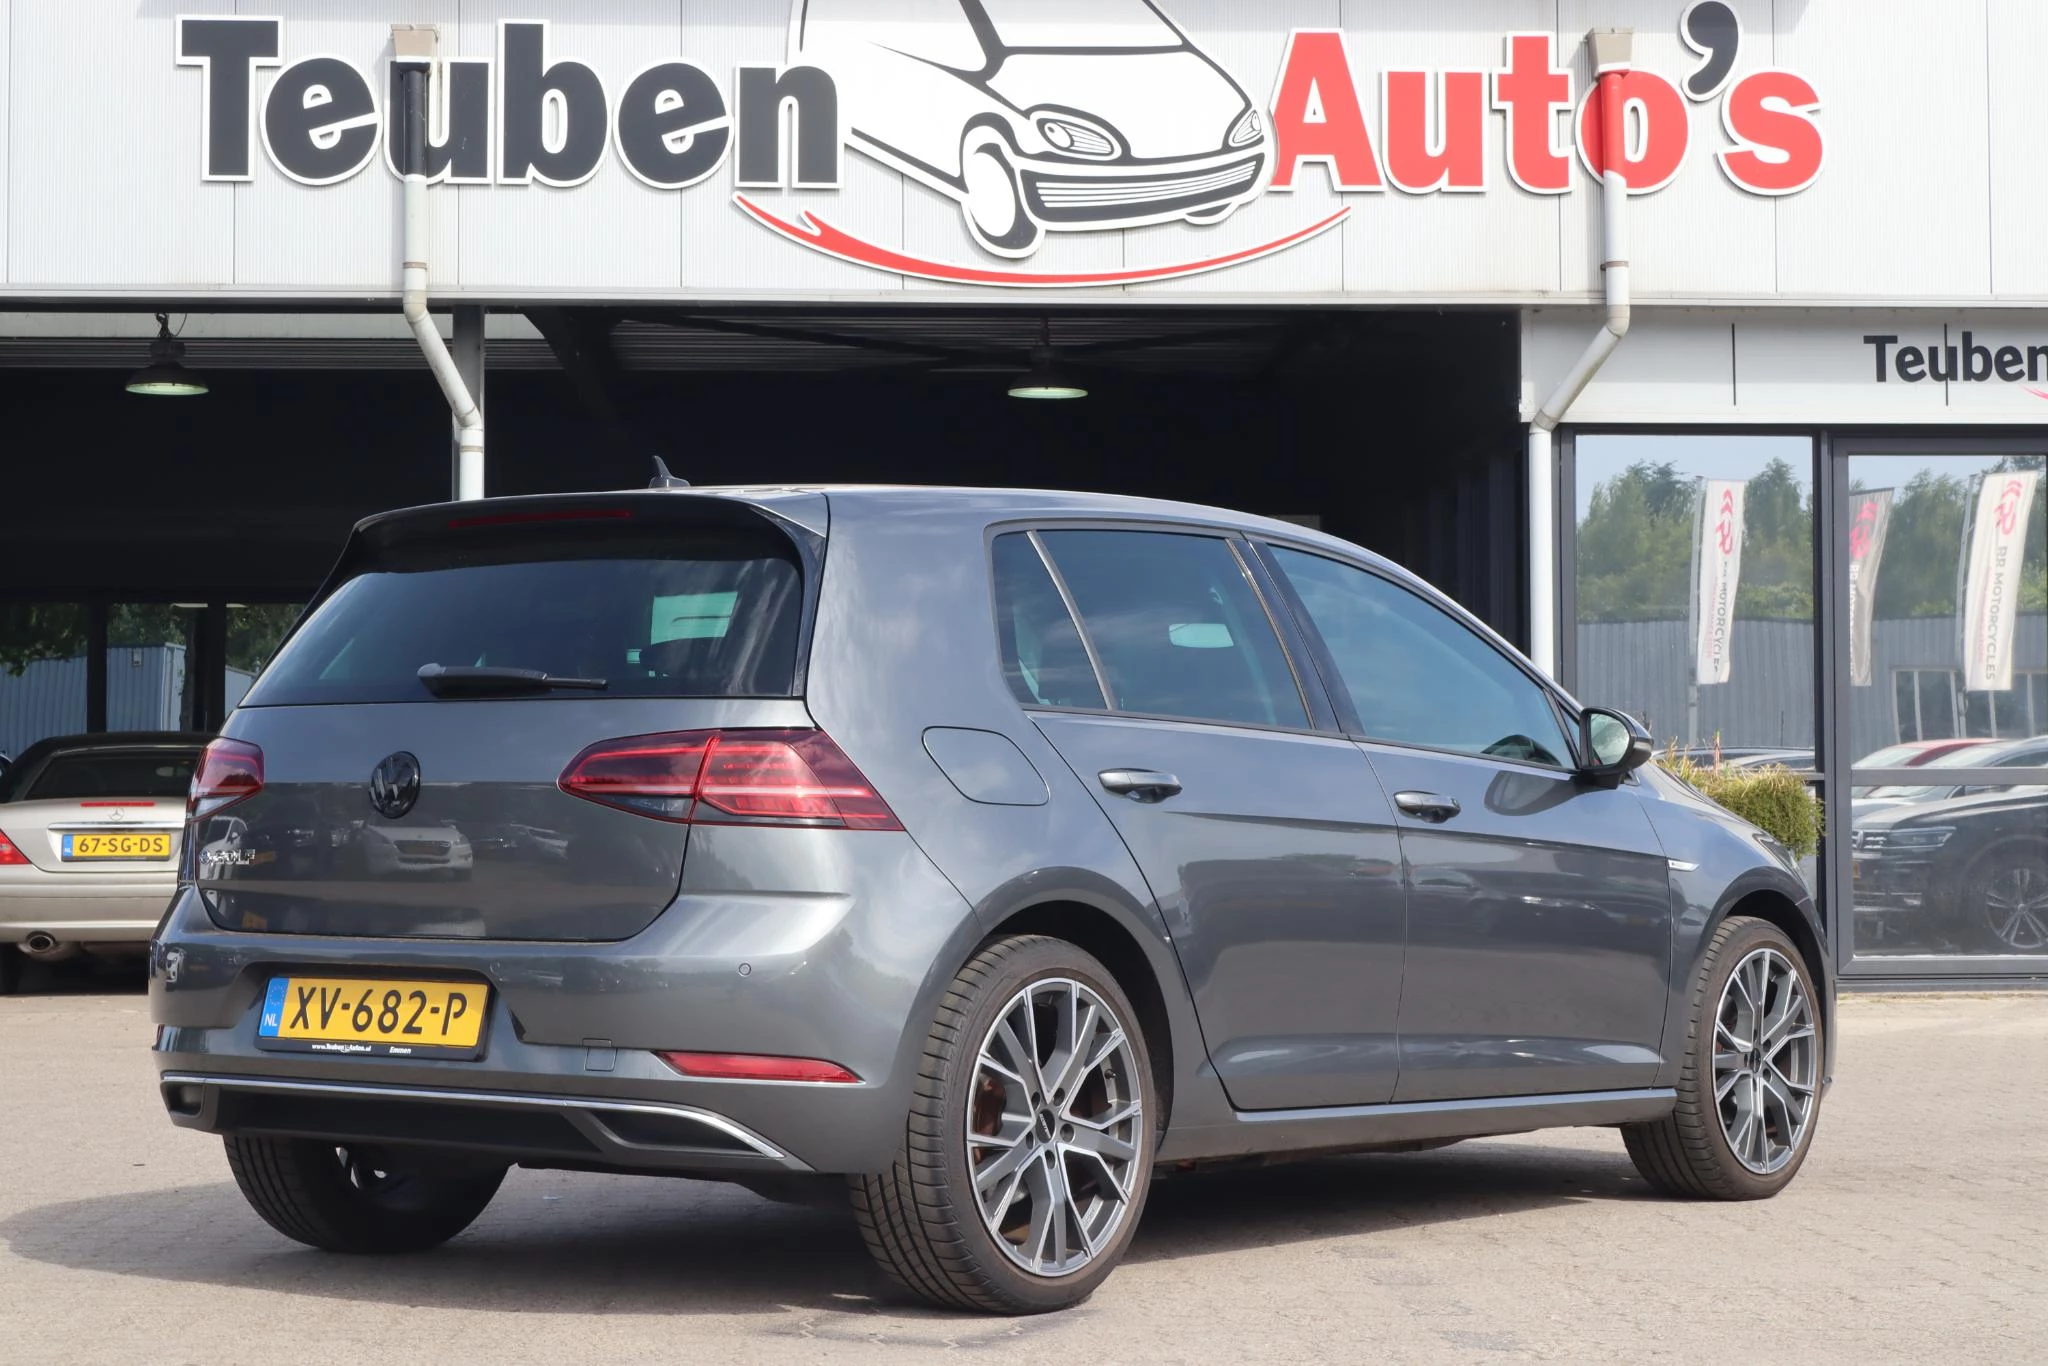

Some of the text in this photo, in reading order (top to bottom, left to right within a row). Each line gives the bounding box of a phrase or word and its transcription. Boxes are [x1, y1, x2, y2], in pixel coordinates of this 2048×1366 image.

[178, 1, 1824, 195] Teuben Auto's
[1863, 331, 2048, 382] Teuben
[1985, 573, 2005, 680] MOTORCYCLES
[79, 837, 163, 853] 67-SG-DS
[264, 1014, 278, 1027] NL
[289, 986, 468, 1036] XV-682-P
